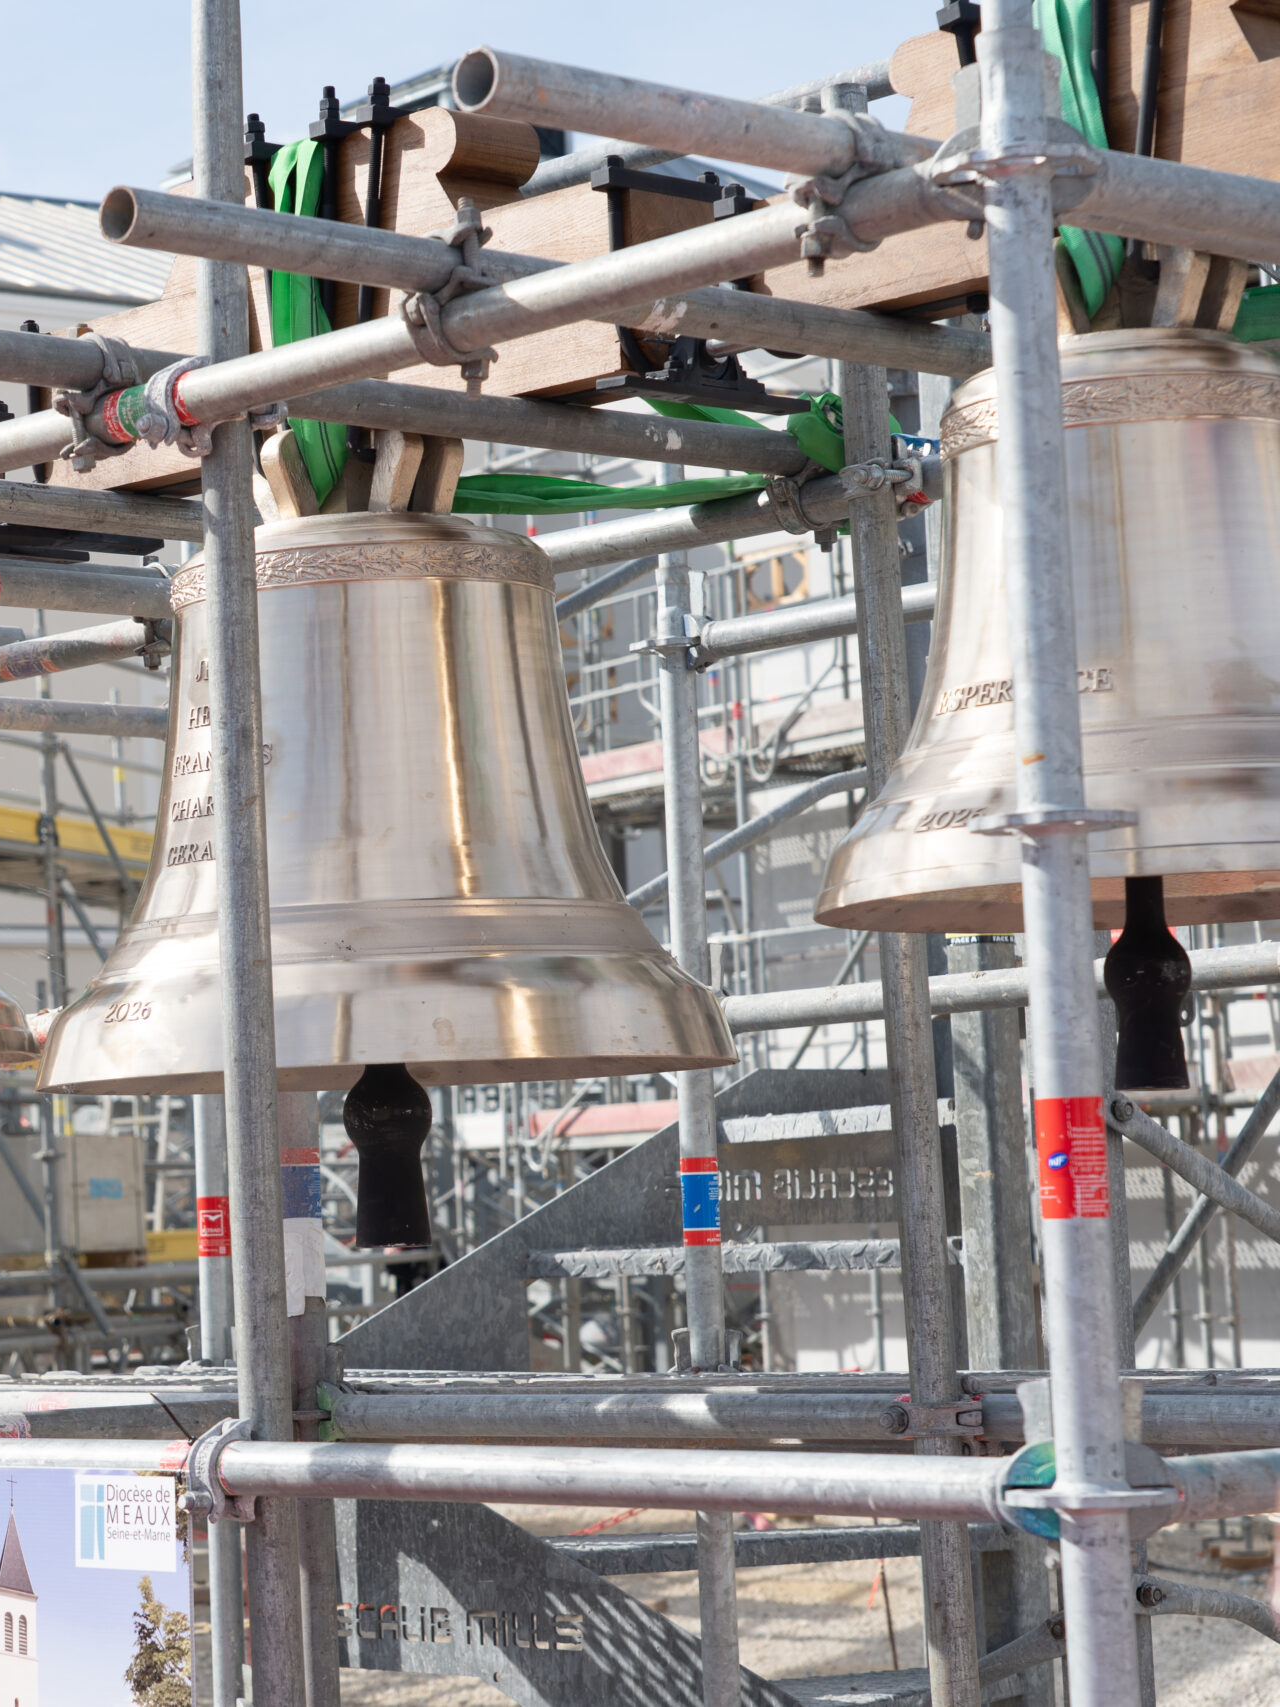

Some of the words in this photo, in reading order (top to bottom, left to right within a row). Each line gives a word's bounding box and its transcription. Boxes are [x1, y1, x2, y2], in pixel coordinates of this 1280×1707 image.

[936, 668, 1113, 716] ESPERCE
[172, 796, 215, 822] CHAR
[104, 1001, 153, 1023] 2026
[106, 1484, 153, 1502] Diocèse
[155, 1484, 170, 1503] de
[106, 1504, 170, 1526] MEAUX
[107, 1526, 171, 1541] Seine-et-Marne
